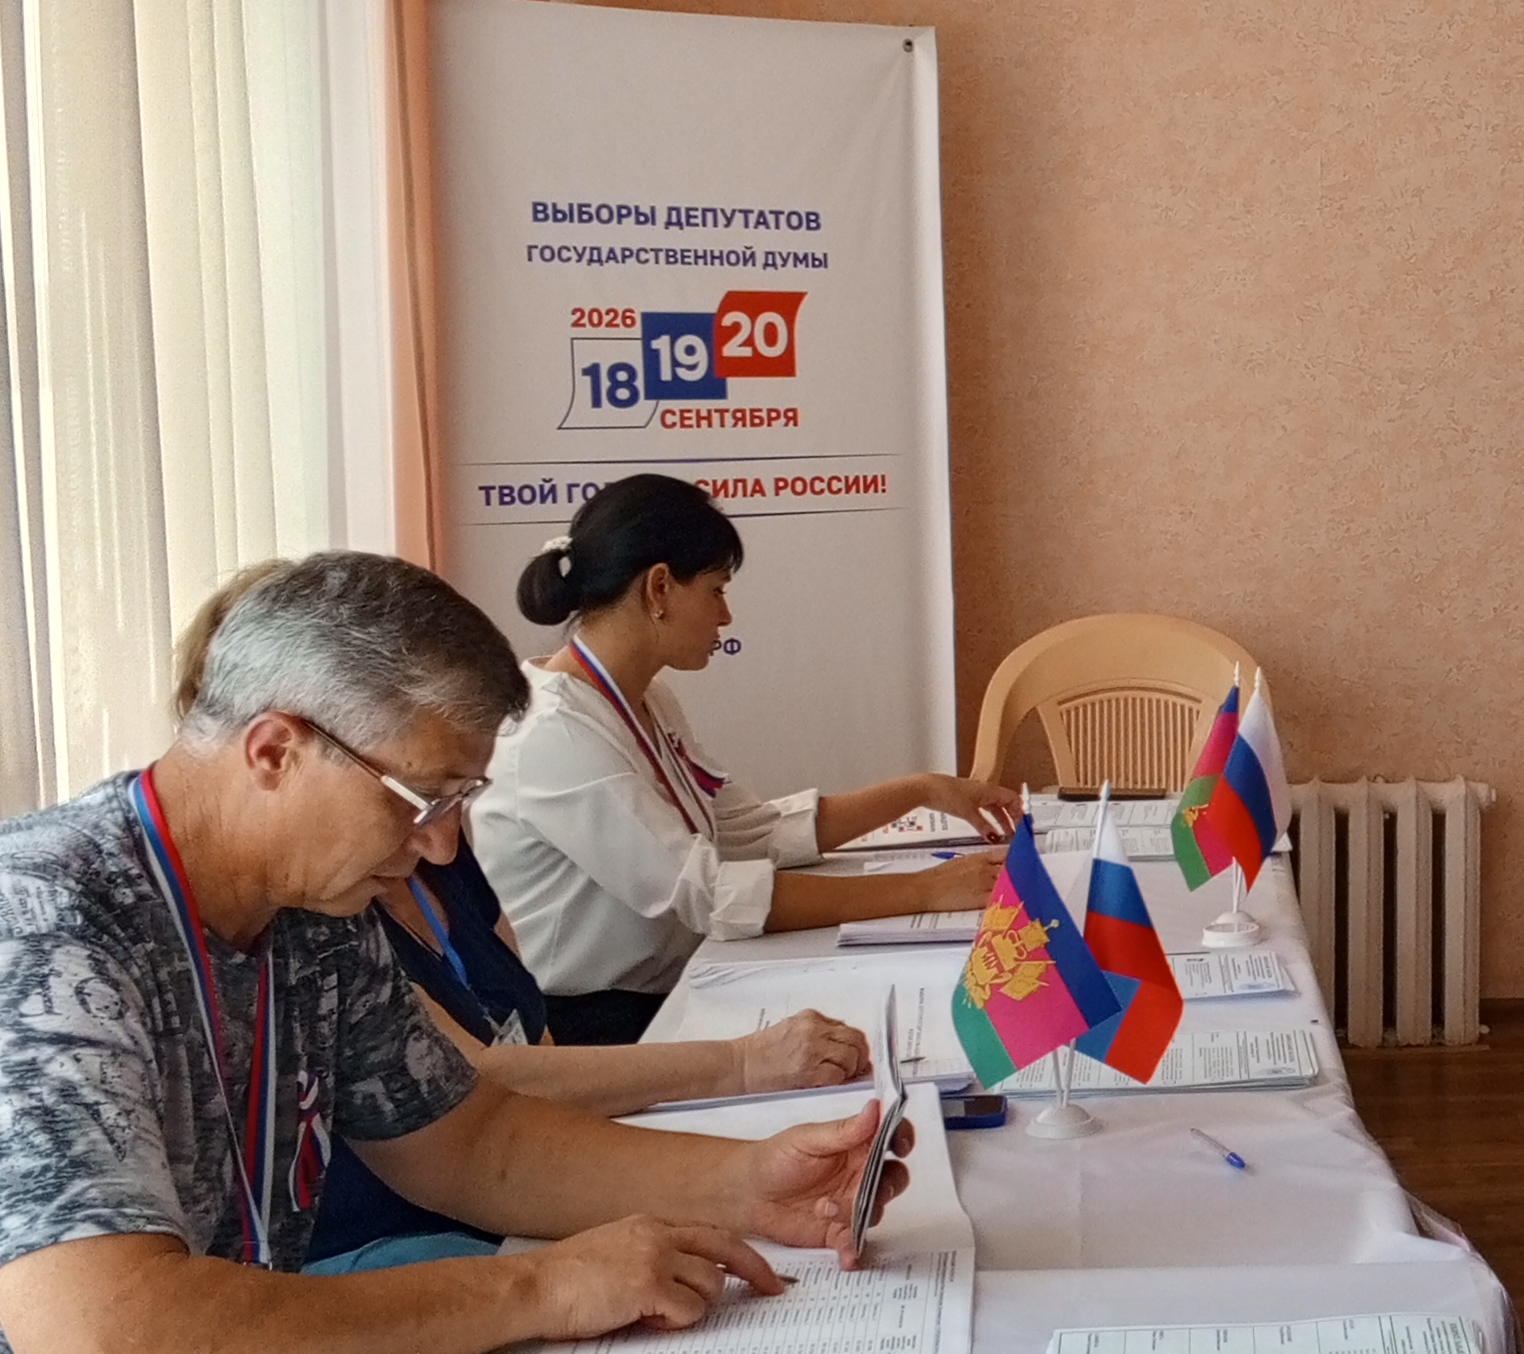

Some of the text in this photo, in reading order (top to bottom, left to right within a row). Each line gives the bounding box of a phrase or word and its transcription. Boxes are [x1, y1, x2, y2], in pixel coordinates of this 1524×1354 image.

[531, 201, 822, 232] ВЫБОРЫ ДЕПУТАТОВ
[526, 244, 829, 270] ГОСУДАРСТВЕННОЙ ДУМЫ
[570, 307, 637, 328] 2026
[581, 311, 789, 409] 18 19 20
[660, 407, 800, 429] СЕНТЯБРЯ
[478, 478, 558, 506] ТВОЙ
[773, 474, 887, 497] РОССИИ!
